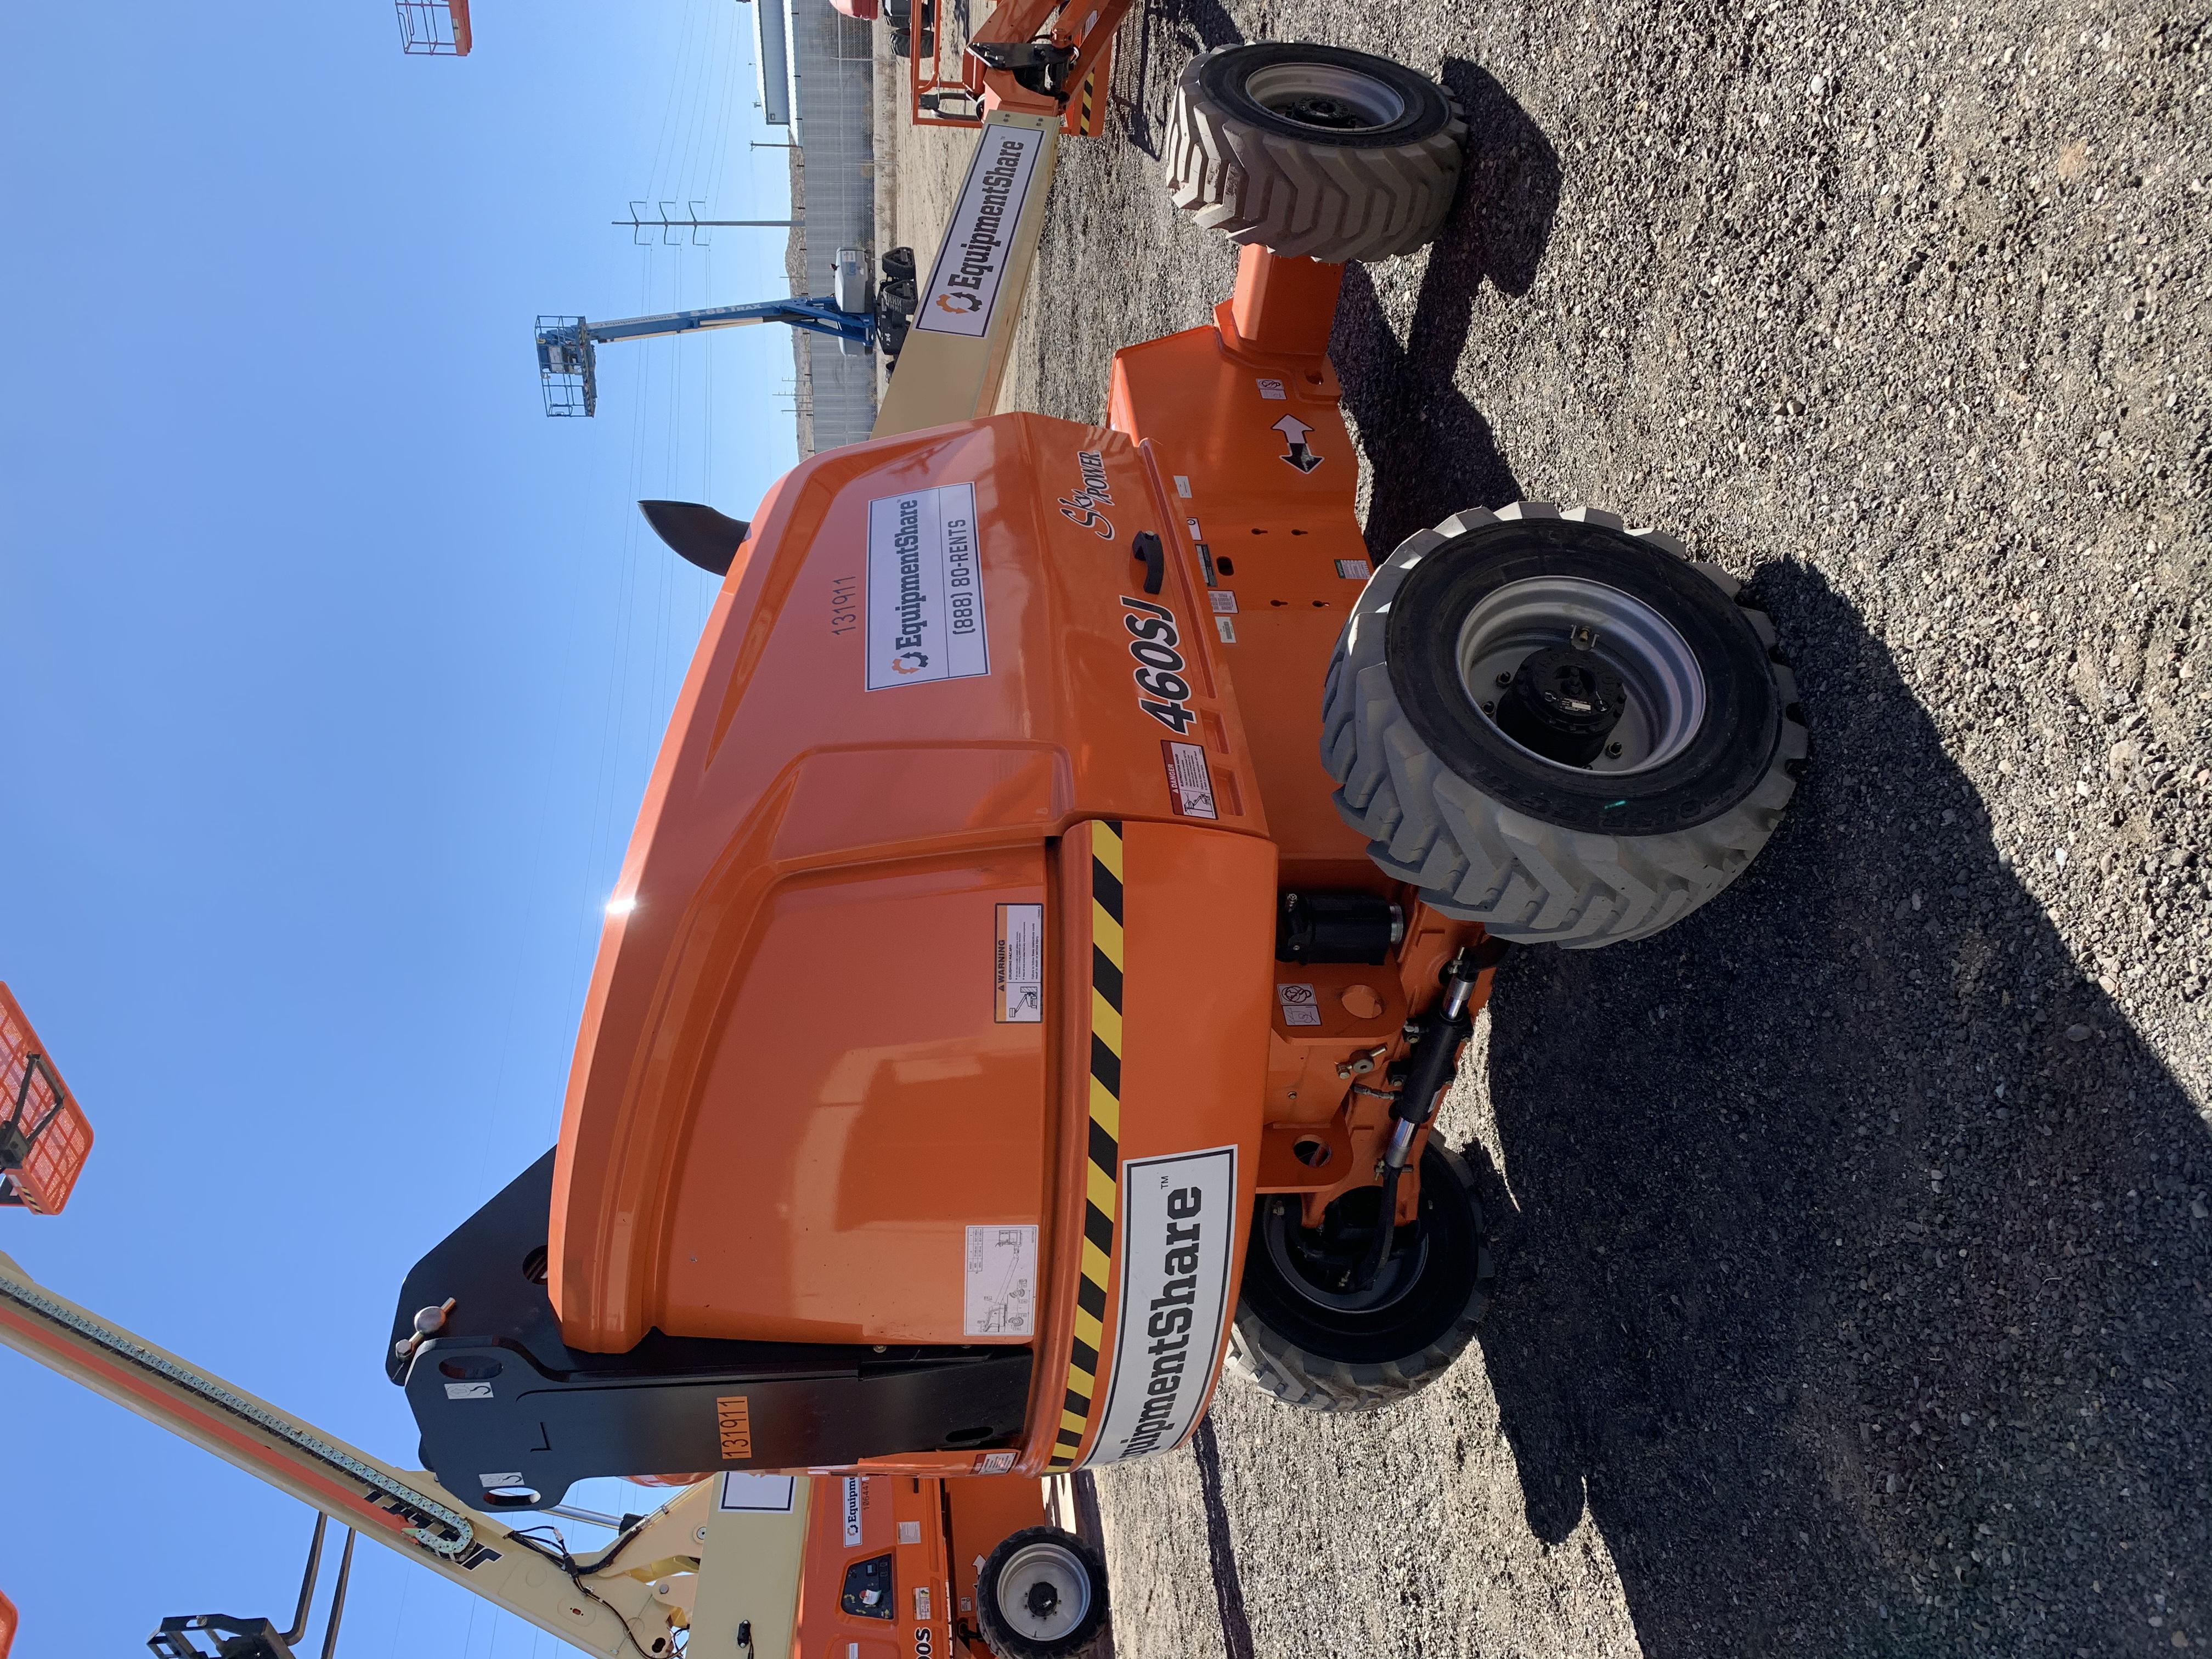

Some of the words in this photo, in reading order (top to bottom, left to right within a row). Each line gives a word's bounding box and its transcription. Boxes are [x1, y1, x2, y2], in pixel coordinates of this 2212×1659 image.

[947, 140, 1024, 290] EquipmentShare
[894, 500, 927, 651] EquipmentShare
[947, 519, 970, 588] 80-RENTS
[831, 576, 856, 635] 131911
[950, 592, 975, 635] (888)
[1120, 595, 1195, 735] 460SJ
[1167, 764, 1178, 788] DANGER
[717, 1401, 749, 1457] 131911
